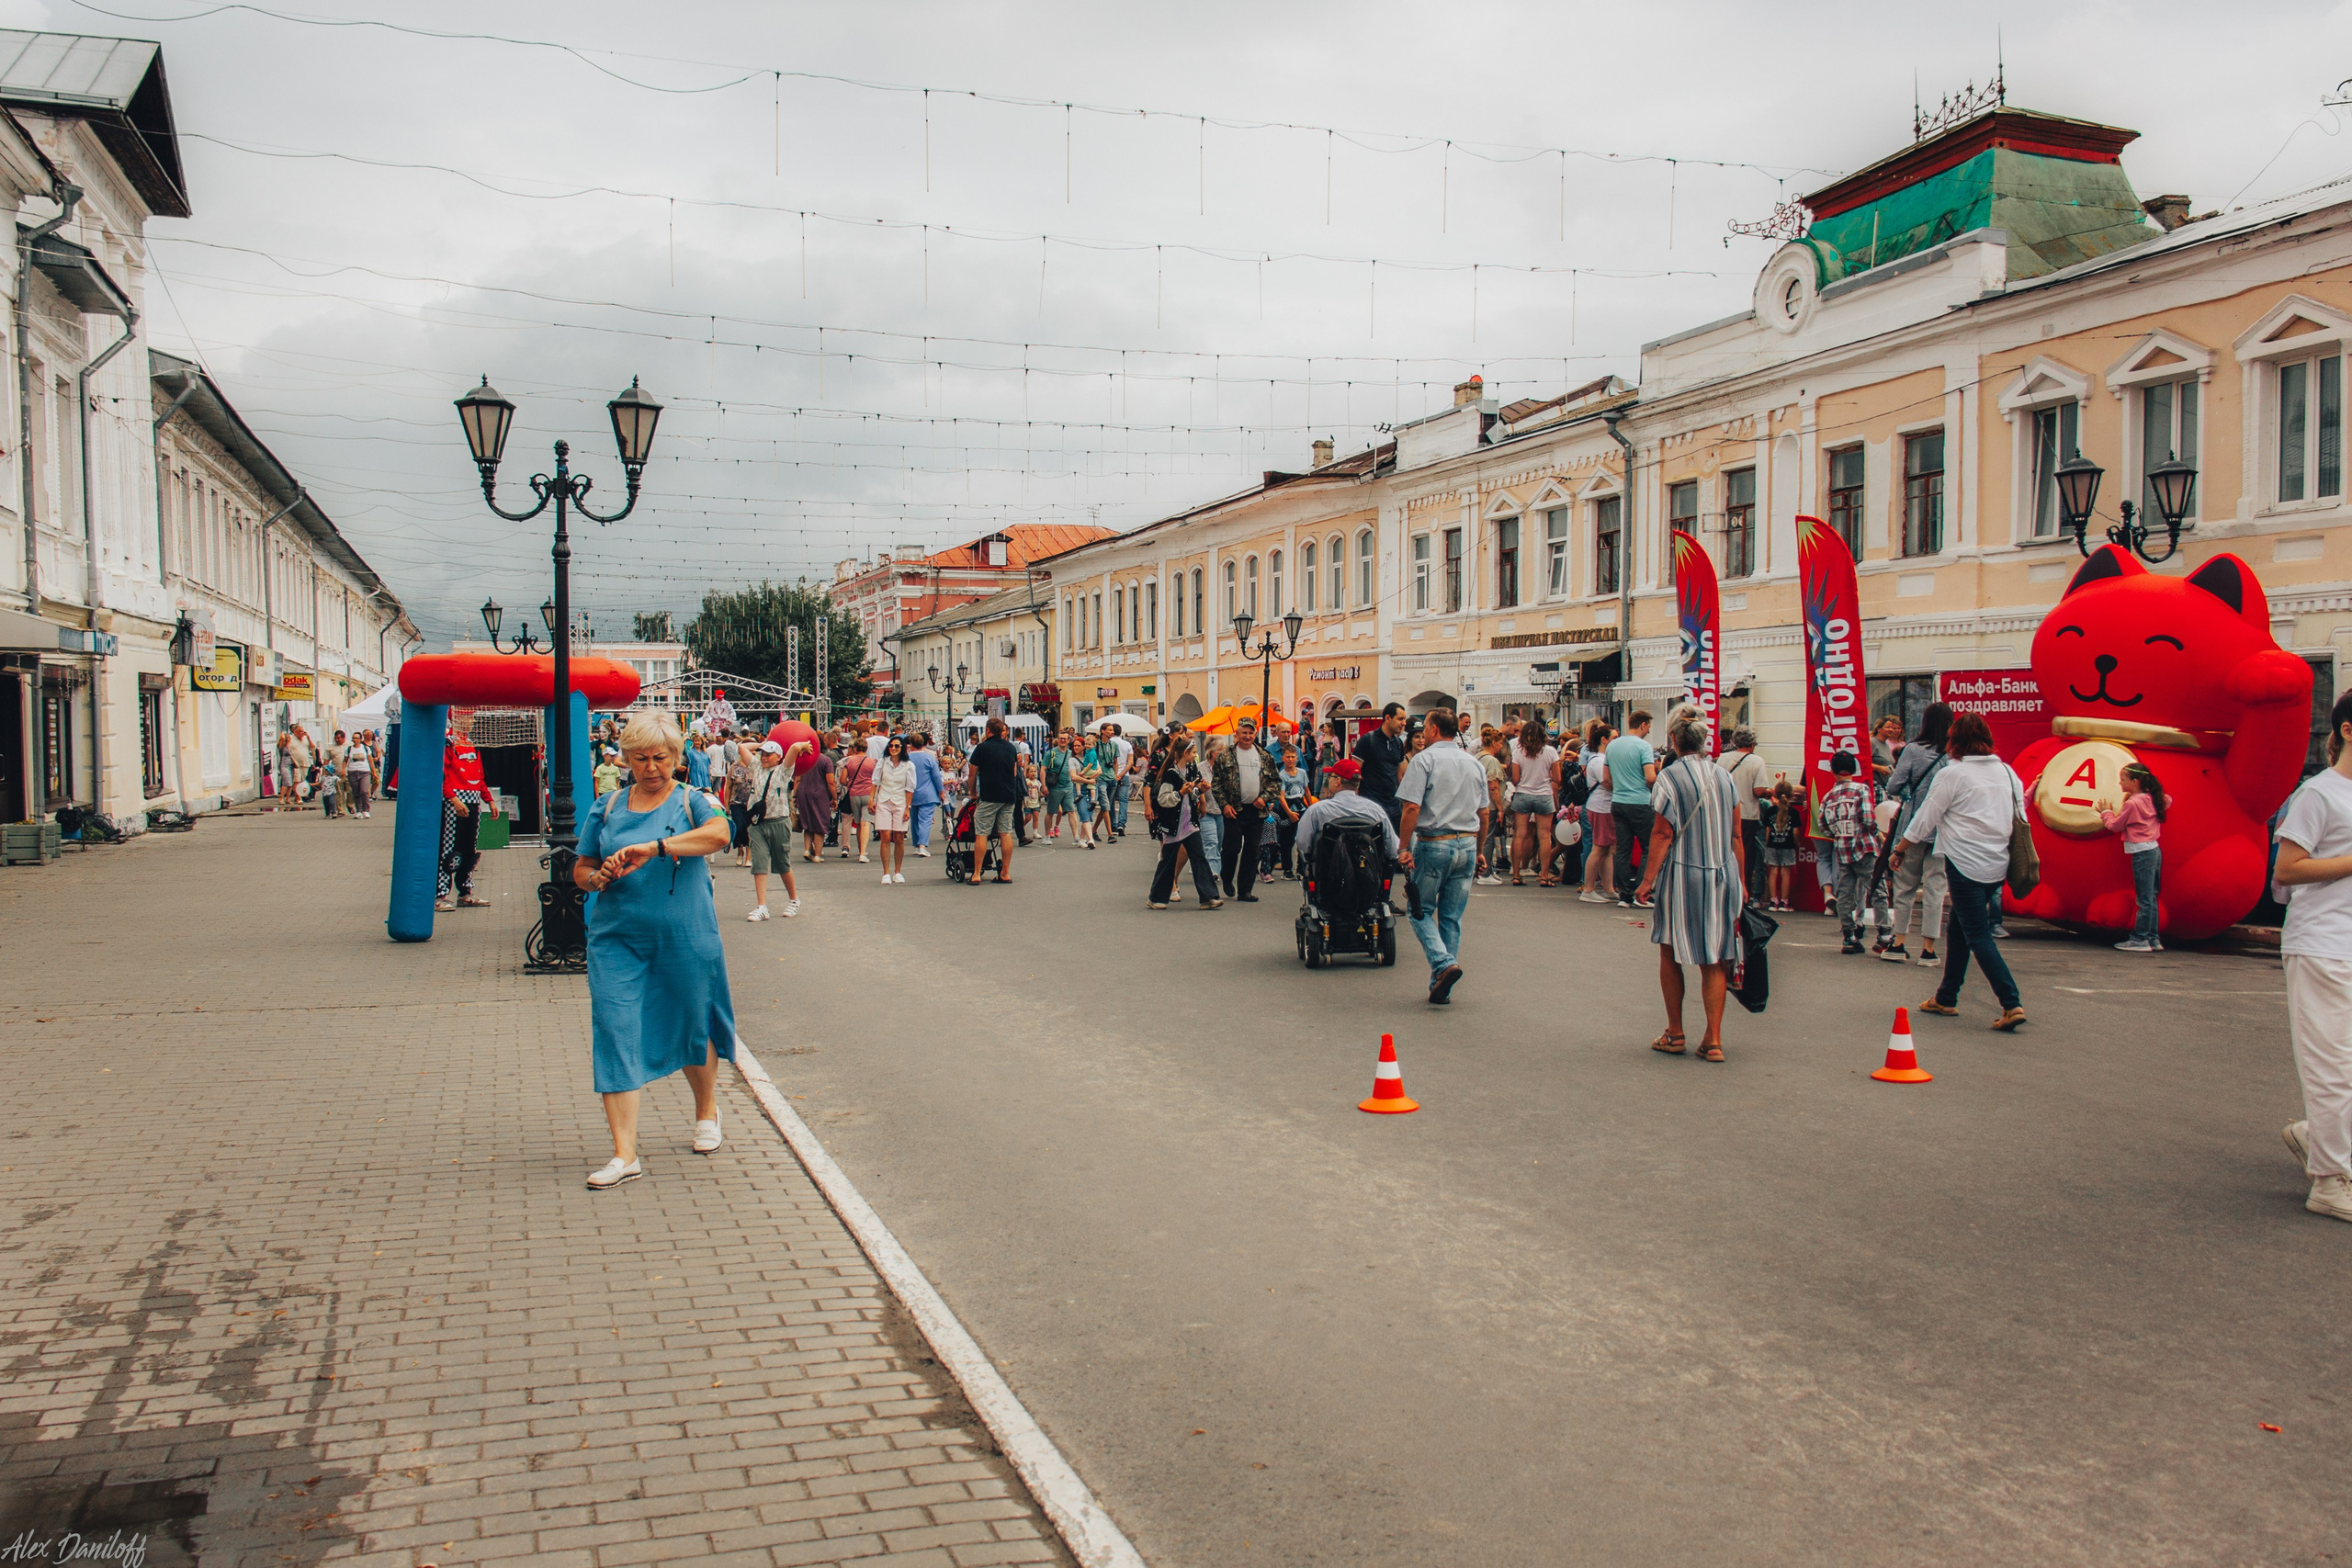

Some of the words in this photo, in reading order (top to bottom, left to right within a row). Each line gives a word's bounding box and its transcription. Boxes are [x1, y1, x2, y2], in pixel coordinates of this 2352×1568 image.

[1490, 633, 1548, 649] ЮВЕЛИРНАЯ
[1551, 626, 1618, 645] МАСТЕРСКАЯ
[198, 674, 238, 682] огорд
[1307, 667, 1336, 681] Ремонт
[1948, 678, 2039, 697] Альфа-Банк
[1824, 617, 1862, 778] ЫГОДНО
[1949, 699, 2043, 716] поздравляет
[1798, 847, 1819, 863] Бан
